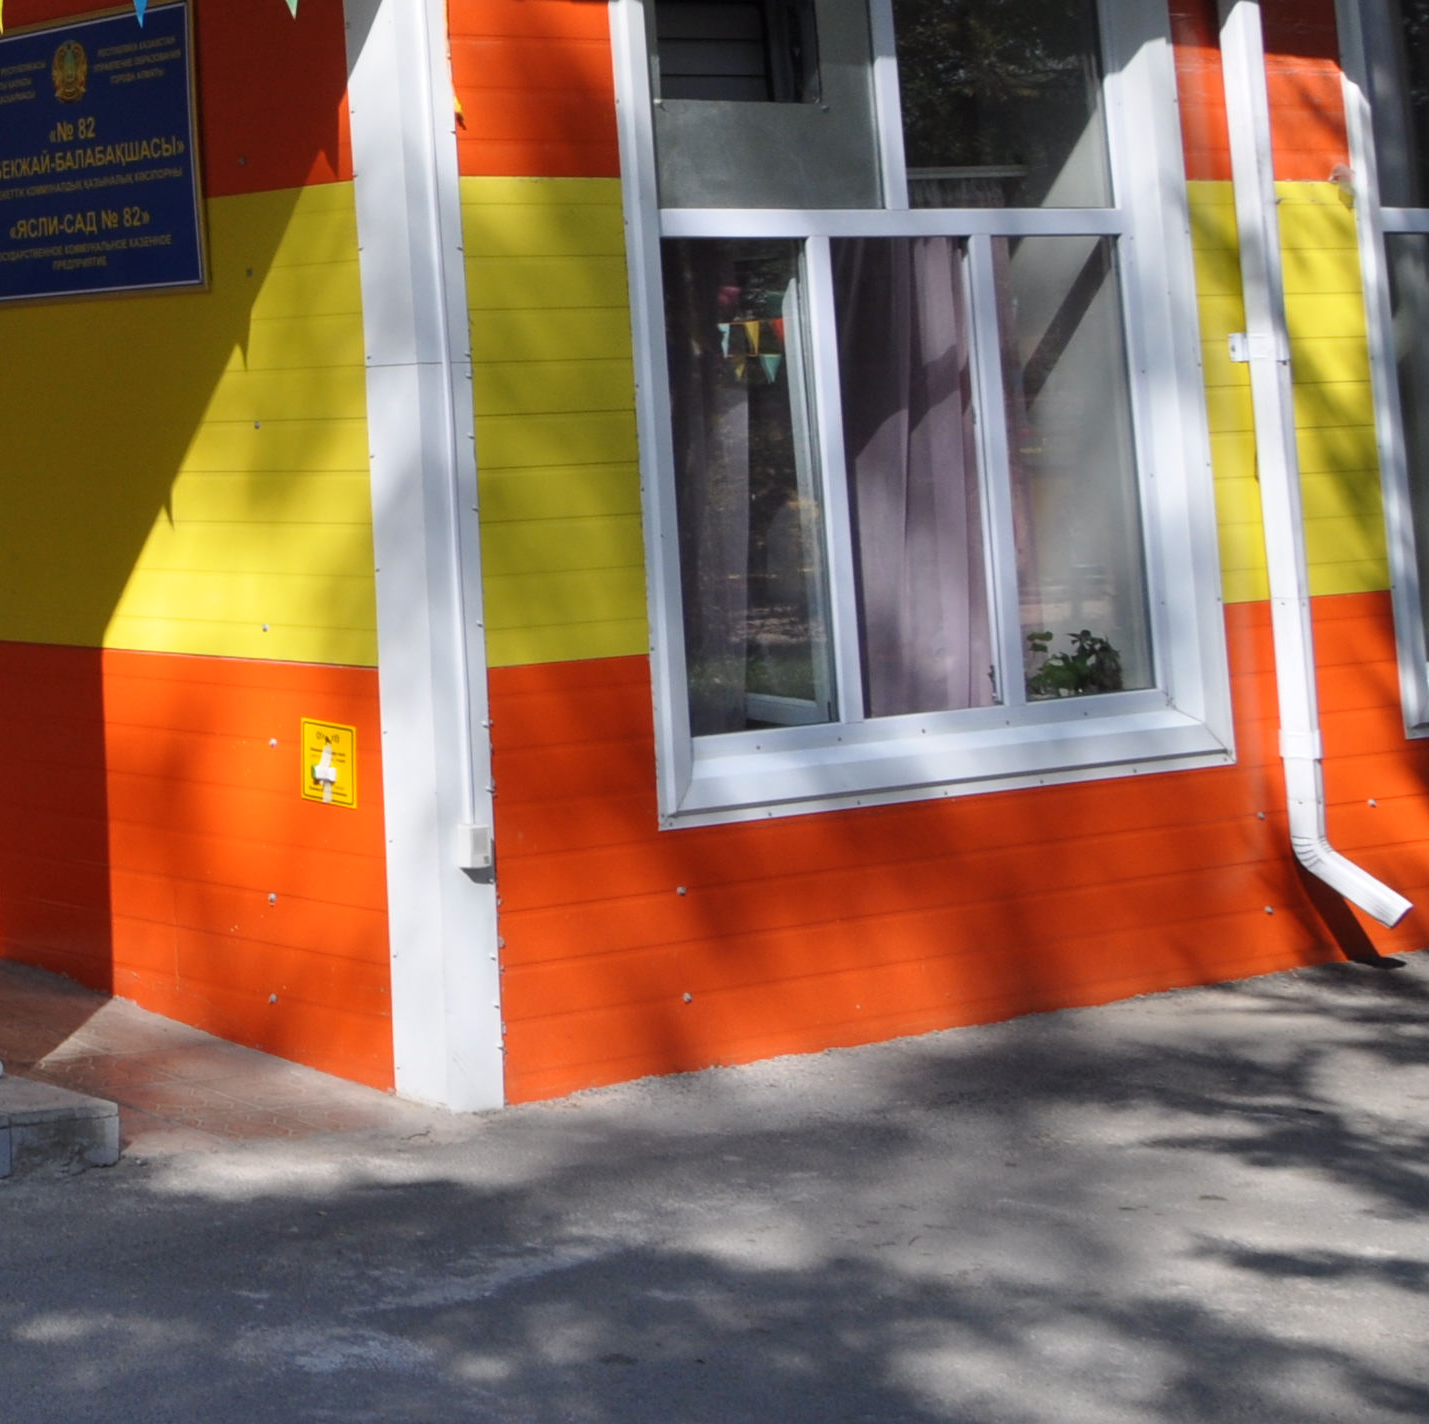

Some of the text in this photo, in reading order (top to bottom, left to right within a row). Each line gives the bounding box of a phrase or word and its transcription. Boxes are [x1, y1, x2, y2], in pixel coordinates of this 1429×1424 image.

[78, 116, 96, 139] 82
[10, 206, 150, 240] «ЯСЛИ-САД № 82»
